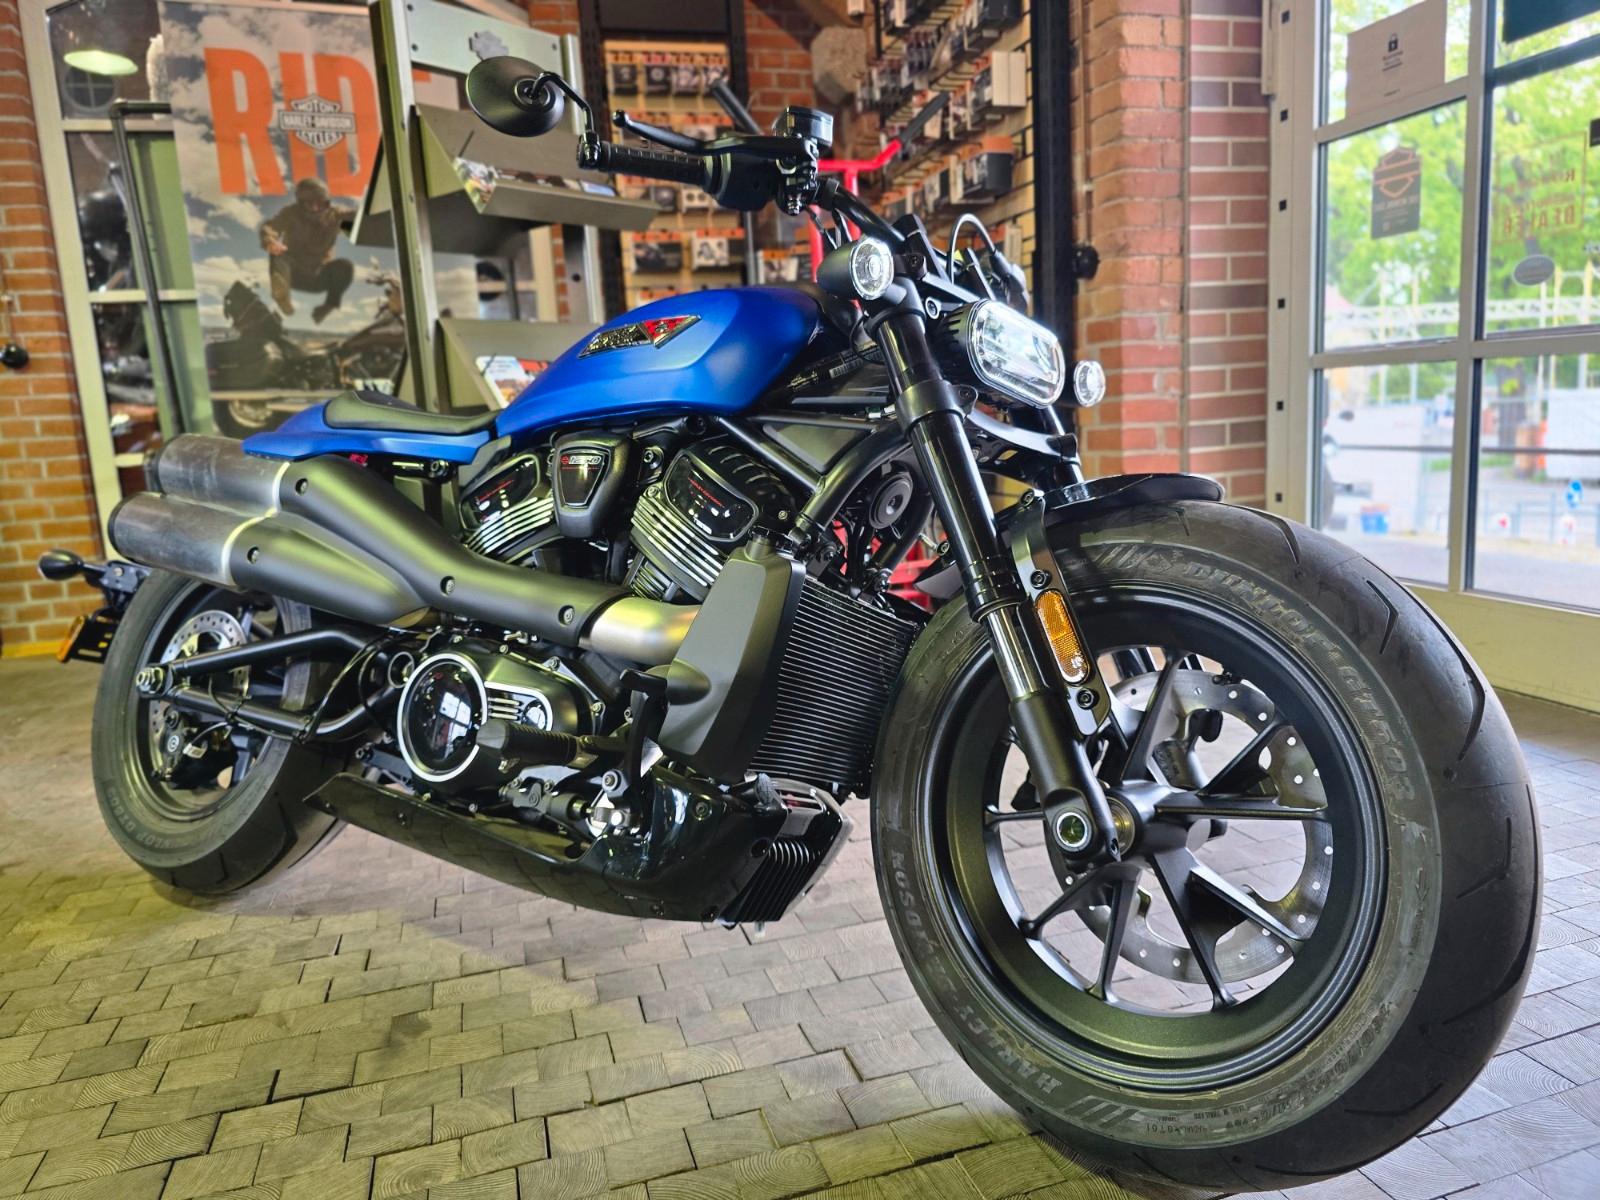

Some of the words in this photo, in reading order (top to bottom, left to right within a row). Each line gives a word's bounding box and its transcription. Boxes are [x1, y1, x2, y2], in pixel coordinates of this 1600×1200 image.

[203, 47, 431, 198] RID
[283, 114, 352, 130] HARLEY-DAVIDSON
[1183, 561, 1343, 654] DUNLOP
[890, 851, 1063, 1095] HARLEY-DAVIDSON
